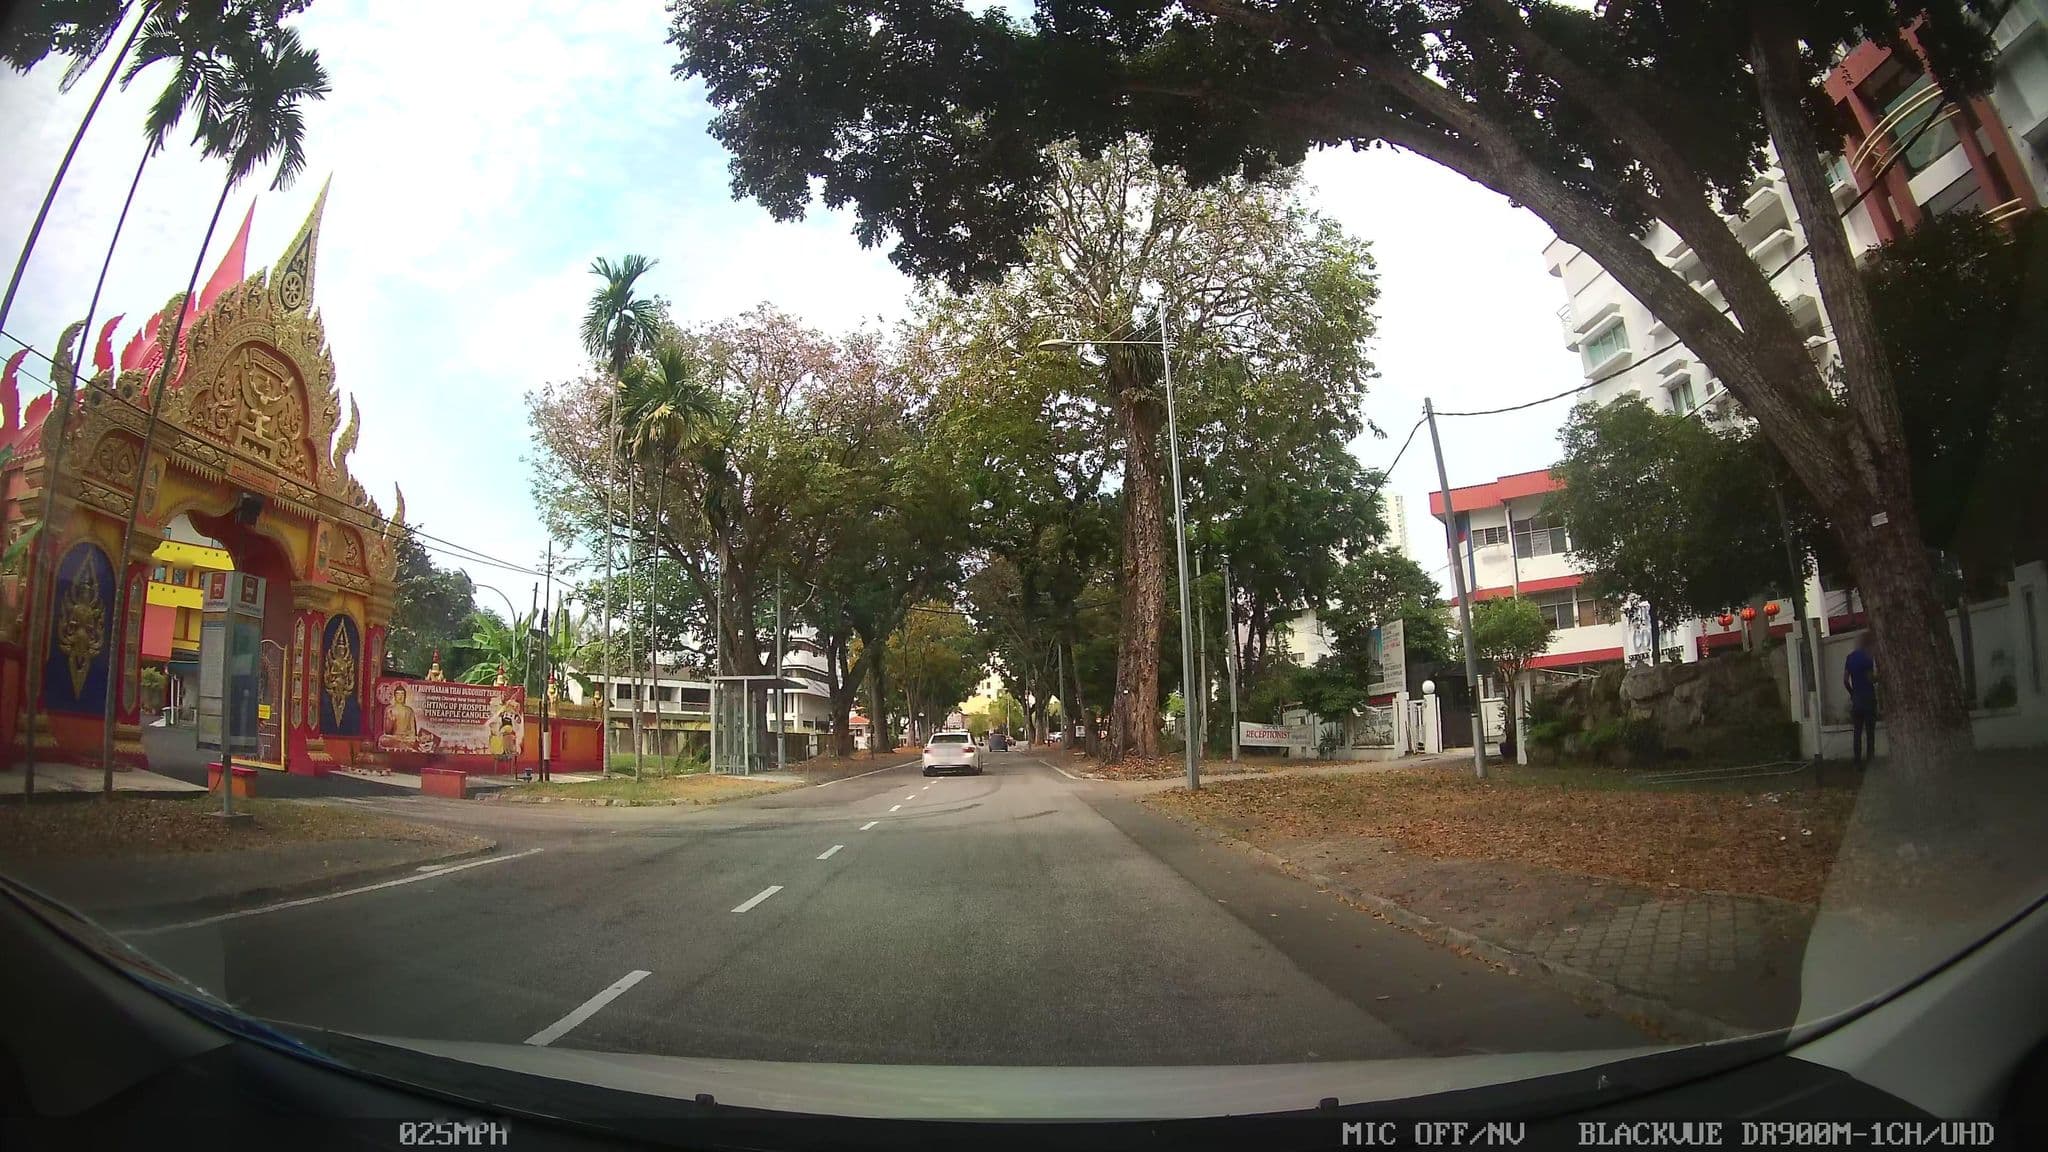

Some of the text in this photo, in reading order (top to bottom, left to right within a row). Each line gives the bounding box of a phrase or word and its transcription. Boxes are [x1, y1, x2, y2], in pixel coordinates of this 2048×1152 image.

[424, 709, 490, 719] PINEAPPLE CANDLES
[1245, 730, 1290, 739] RECEPTIONIST
